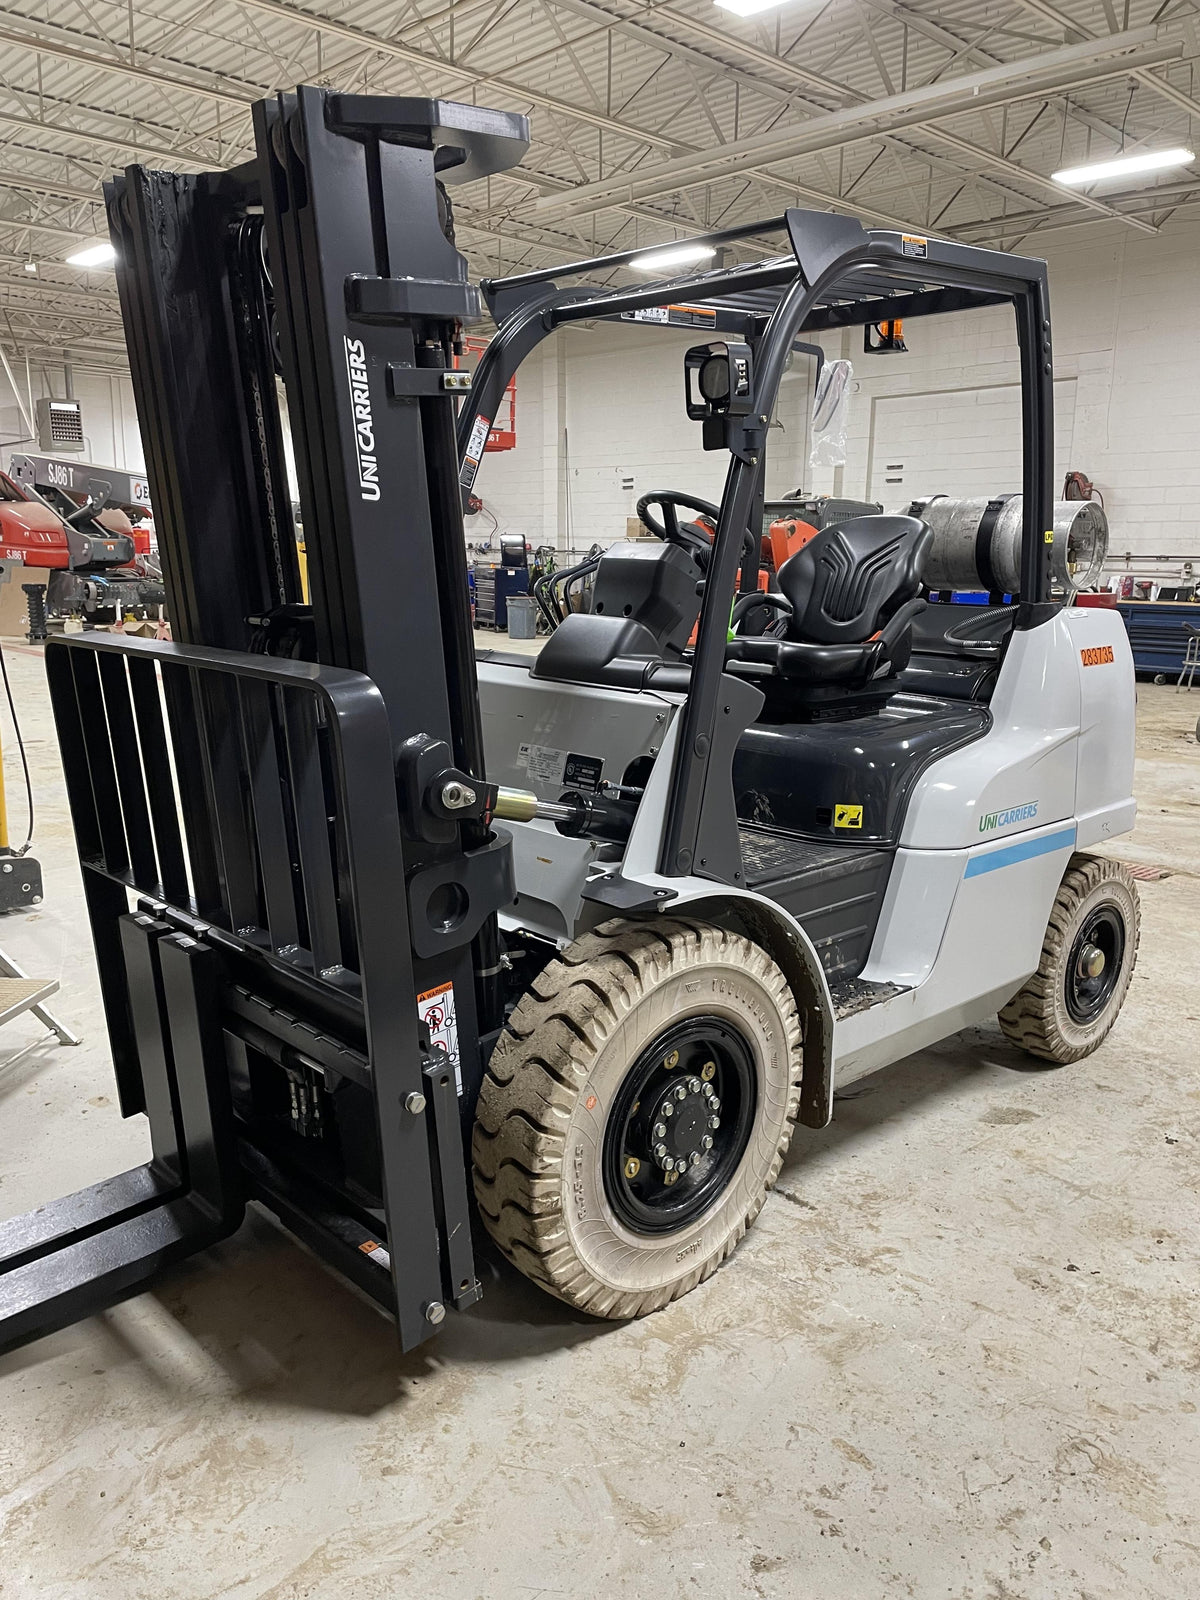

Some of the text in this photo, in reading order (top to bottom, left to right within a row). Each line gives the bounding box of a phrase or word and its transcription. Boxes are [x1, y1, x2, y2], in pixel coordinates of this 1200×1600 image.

[48, 463, 68, 486] SJ86
[1080, 645, 1114, 667] 283735
[979, 800, 1039, 832] UNICARRIERS
[426, 984, 452, 999] WARNING
